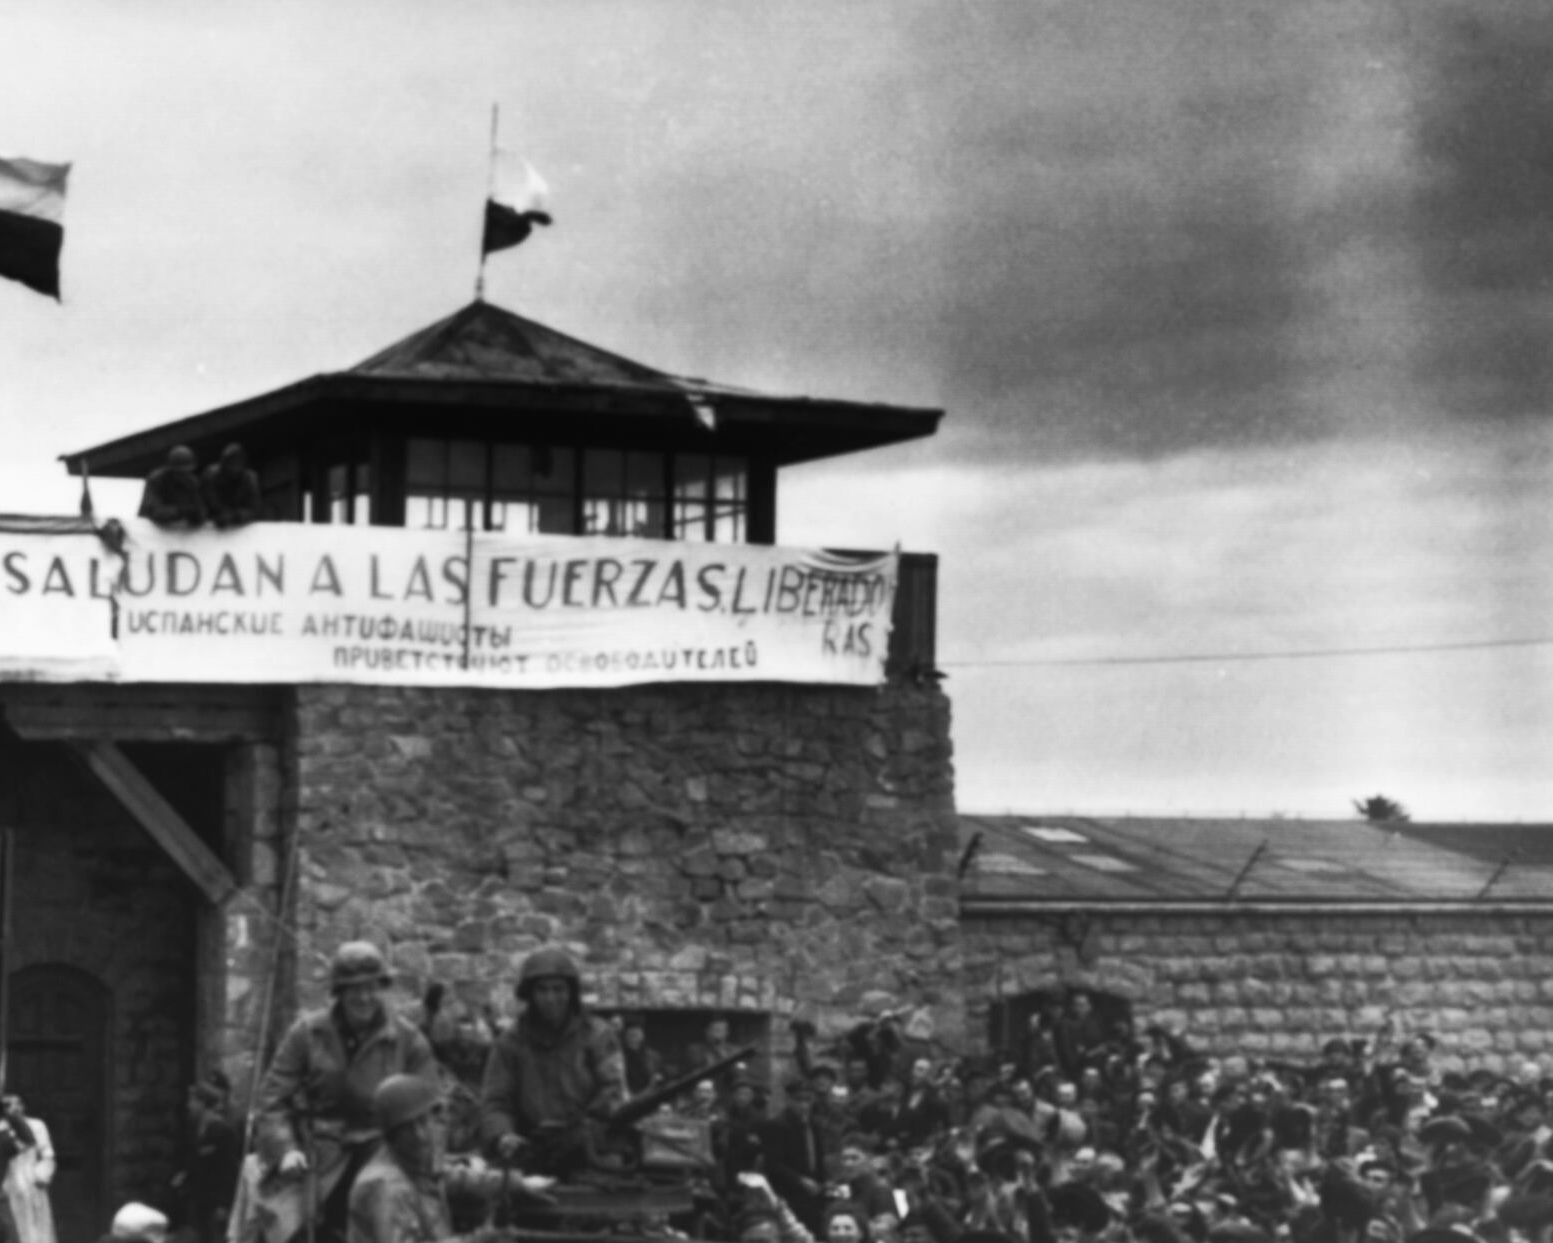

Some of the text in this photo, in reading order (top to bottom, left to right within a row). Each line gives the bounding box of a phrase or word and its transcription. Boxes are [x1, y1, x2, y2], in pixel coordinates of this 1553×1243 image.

[3, 551, 285, 599] SALUDAN
[310, 554, 343, 598] A
[369, 554, 469, 605] LAS
